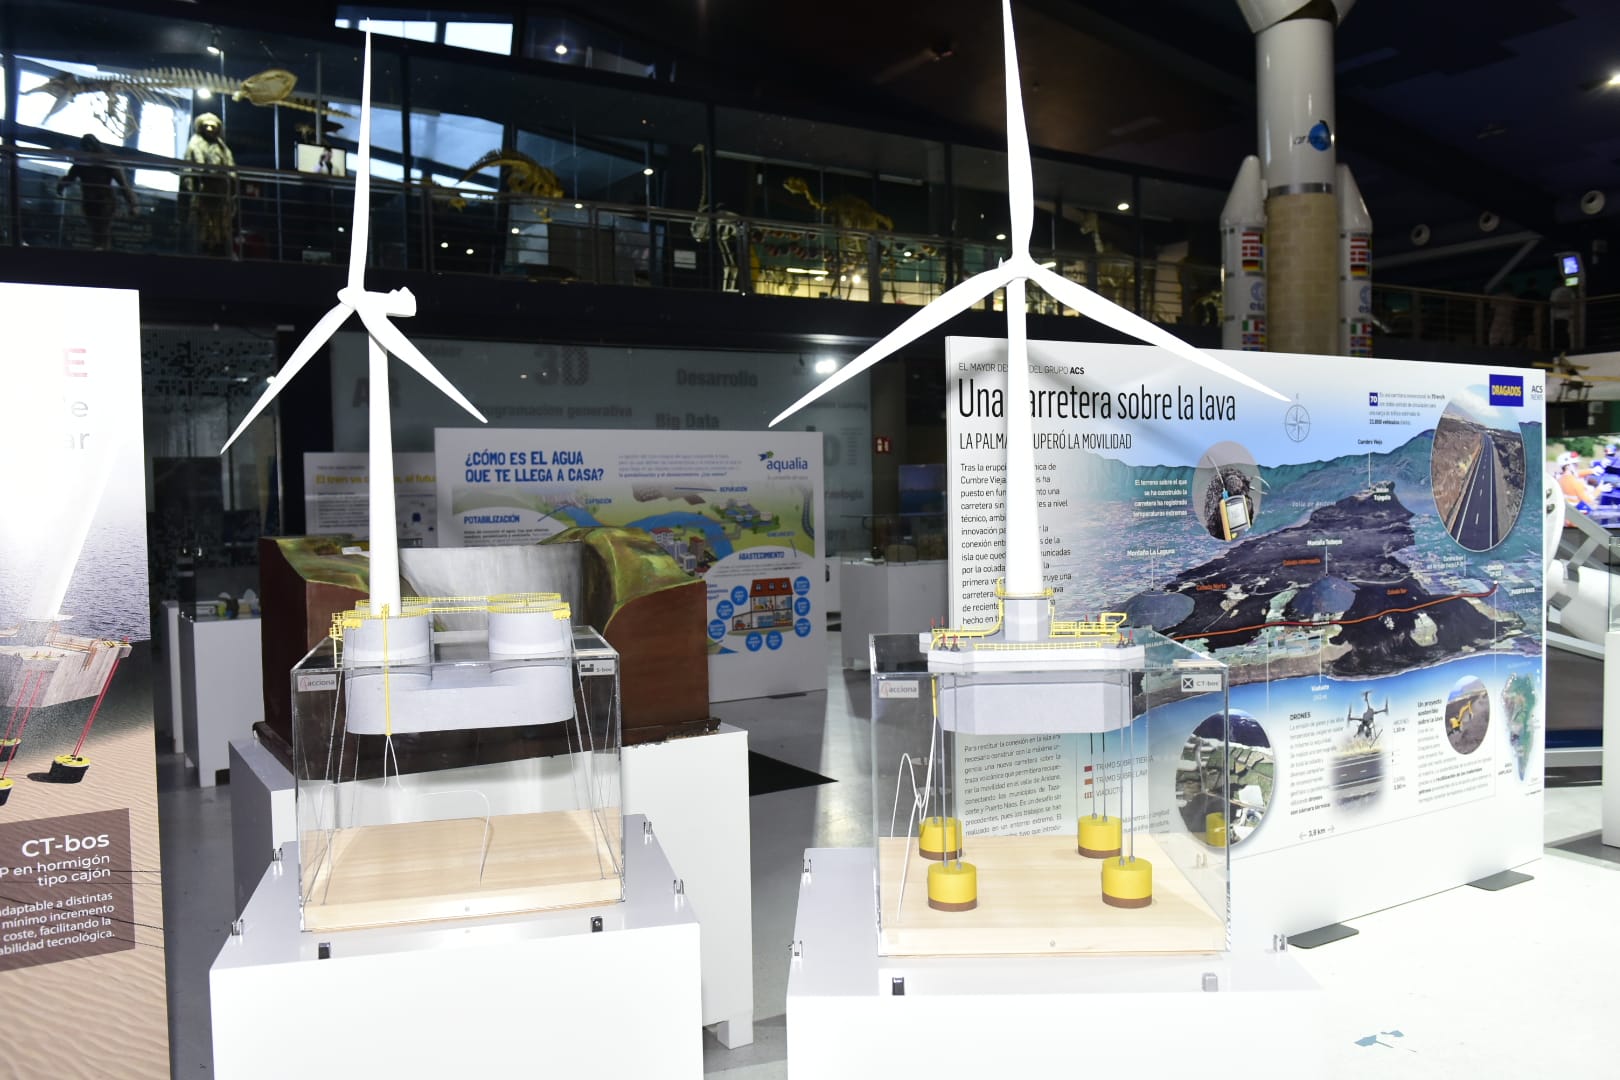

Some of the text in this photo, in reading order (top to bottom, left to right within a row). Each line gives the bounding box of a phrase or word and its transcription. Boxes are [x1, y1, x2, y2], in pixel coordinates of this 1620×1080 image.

[959, 362, 969, 372] EL
[970, 362, 996, 373] MAYOR
[1044, 365, 1069, 375] GRUPO
[1069, 366, 1085, 375] ACS
[676, 368, 758, 388] Desarrollo
[1491, 384, 1522, 397] DRAGADOS
[1531, 385, 1544, 394] ACS
[958, 377, 1004, 418] Una
[1117, 383, 1172, 420] sobre
[1178, 385, 1194, 420] la
[1199, 386, 1236, 421] lava
[656, 412, 720, 430] Big Data
[960, 432, 973, 450] LA
[1068, 433, 1081, 450] LA
[1082, 433, 1132, 450] MOVILIDAD
[465, 448, 584, 467] ¿CÓMO ES EL AGUA
[766, 457, 808, 473] aqualia
[960, 462, 1057, 473] Tras la erupci de
[465, 469, 491, 483] QUE
[495, 469, 511, 483] TE
[514, 469, 553, 483] LLEGA
[556, 469, 565, 482] A
[568, 468, 605, 482] CASA?
[960, 475, 989, 485] Cumbre
[1042, 475, 1051, 483] ha
[960, 488, 1060, 498] puesto en una
[960, 501, 993, 511] carretera
[994, 501, 1005, 510] sin
[1053, 499, 1069, 508] nivel
[961, 513, 988, 524] técnico,
[961, 526, 998, 536] innovación
[961, 536, 1060, 549] conexión de la
[961, 547, 1071, 562] isla que unicadas
[961, 566, 974, 576] por
[975, 564, 982, 574] la
[962, 572, 1072, 588] primera una
[962, 590, 994, 600] carretera
[962, 603, 972, 613] de
[962, 615, 994, 626] hecho en
[307, 679, 335, 687] acciona
[888, 686, 917, 694] acciona
[1289, 711, 1311, 721] DRONES
[21, 833, 110, 858] CT-bos
[13, 865, 33, 877] en
[37, 853, 110, 874] hormigón
[37, 866, 111, 888] tipo cajón
[55, 900, 63, 909] a
[65, 892, 113, 908] distintas
[2, 905, 115, 929] mínimo incremento
[3, 916, 112, 943] coste, facilitando la
[47, 929, 116, 948] tecnológica.
